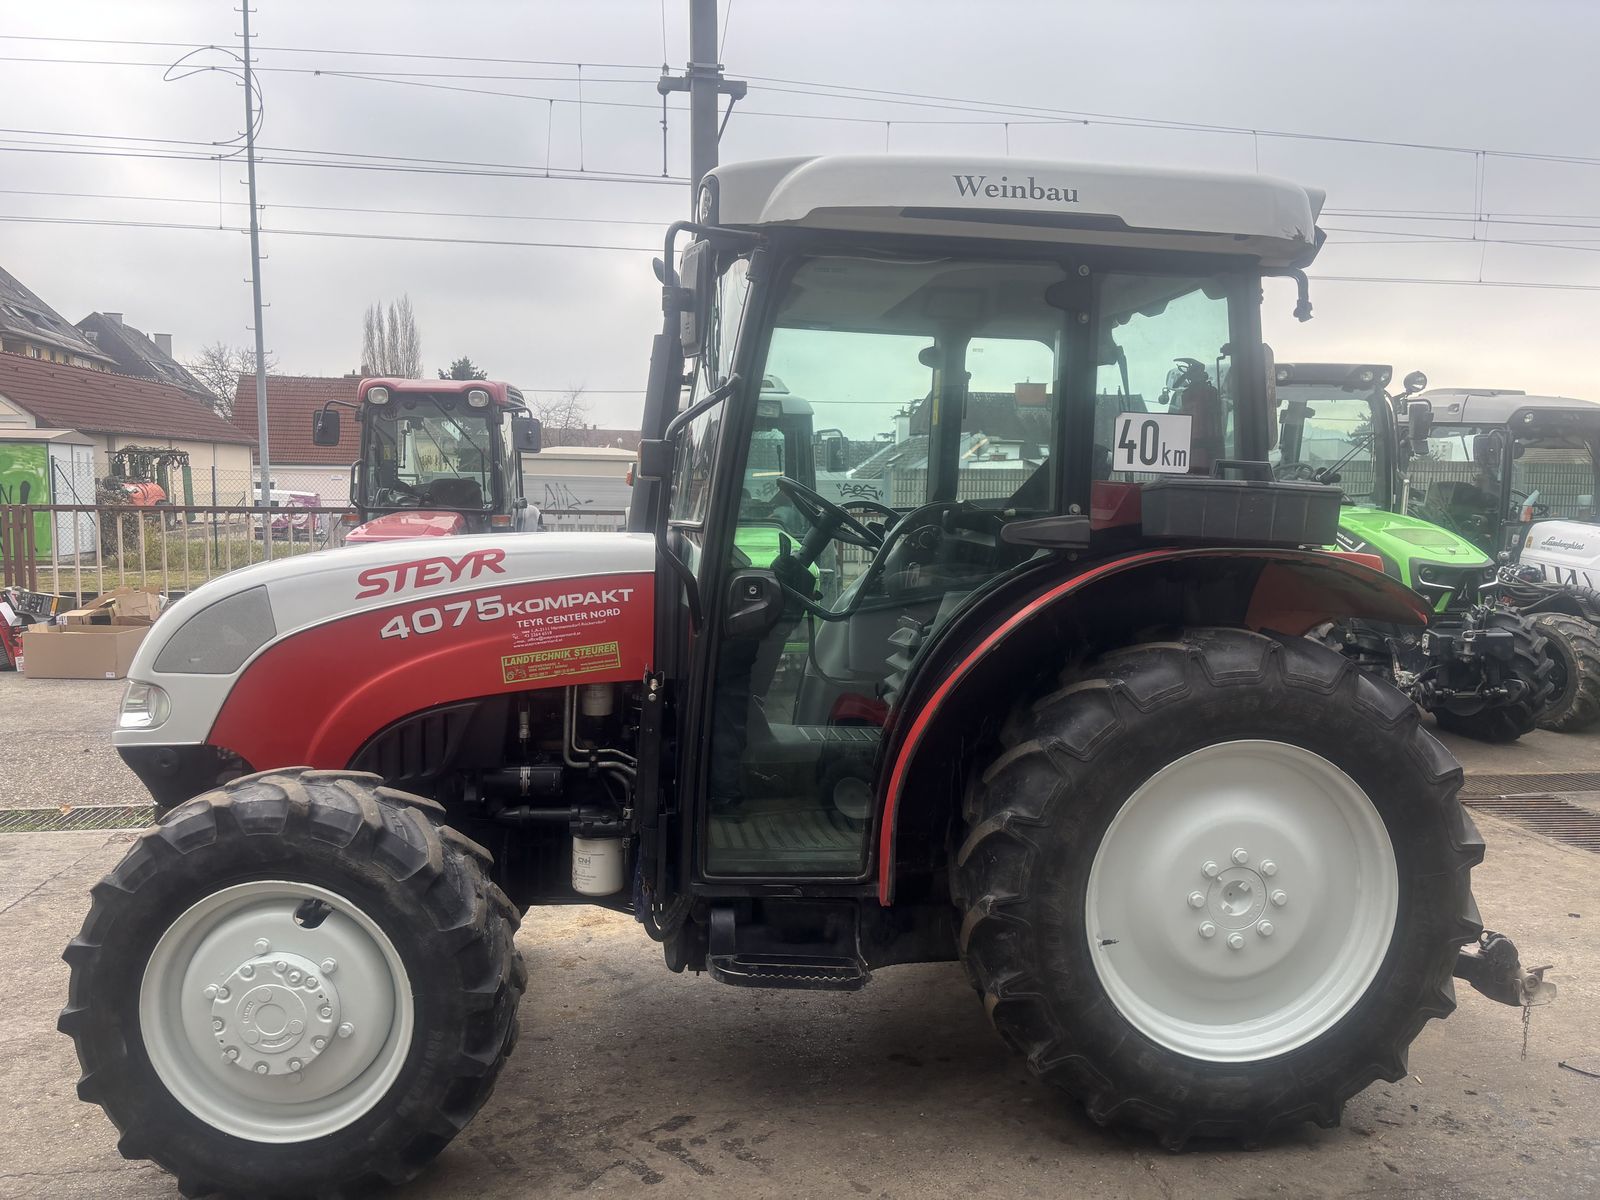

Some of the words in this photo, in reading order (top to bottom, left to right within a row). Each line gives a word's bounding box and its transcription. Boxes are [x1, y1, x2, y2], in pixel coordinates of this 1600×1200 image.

[952, 175, 1079, 203] Weinbau
[1118, 419, 1160, 466] 40
[1161, 441, 1187, 467] km
[355, 548, 506, 600] STEYR
[380, 595, 506, 639] 4075
[507, 588, 634, 616] KOMPAKT
[517, 617, 544, 628] TEYR
[546, 611, 588, 624] CENTER
[590, 607, 621, 619] NORD
[504, 649, 571, 667] LANDTECHNIK
[574, 644, 617, 657] STEURER
